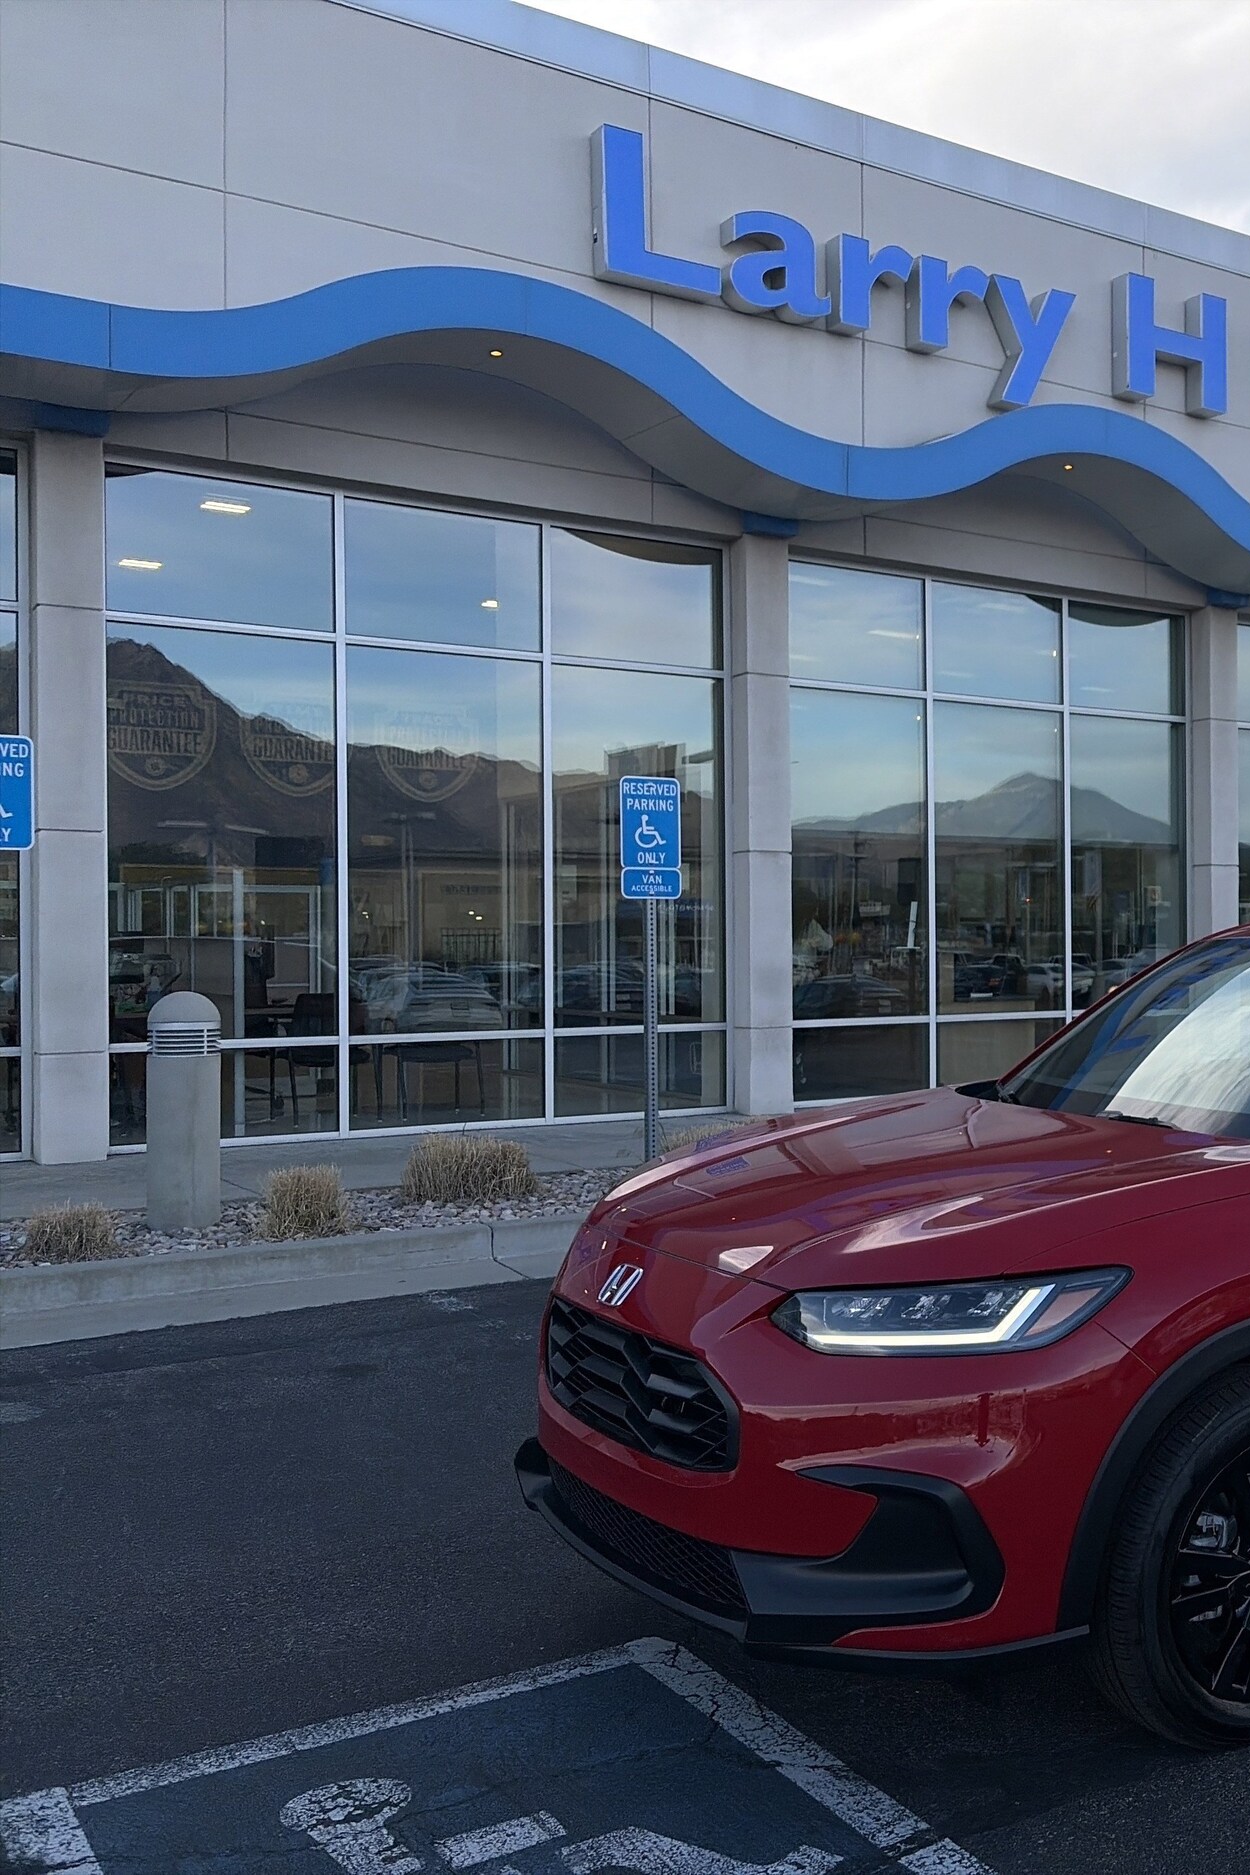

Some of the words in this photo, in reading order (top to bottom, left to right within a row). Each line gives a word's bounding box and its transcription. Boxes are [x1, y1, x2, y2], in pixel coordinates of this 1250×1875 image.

[597, 122, 1076, 410] Larry
[1116, 271, 1227, 417] H
[623, 782, 677, 797] RESERVED
[626, 798, 674, 812] PARKING
[637, 852, 666, 864] ONLY
[642, 874, 662, 885] VAN
[631, 884, 672, 893] ACCESSIBLE
